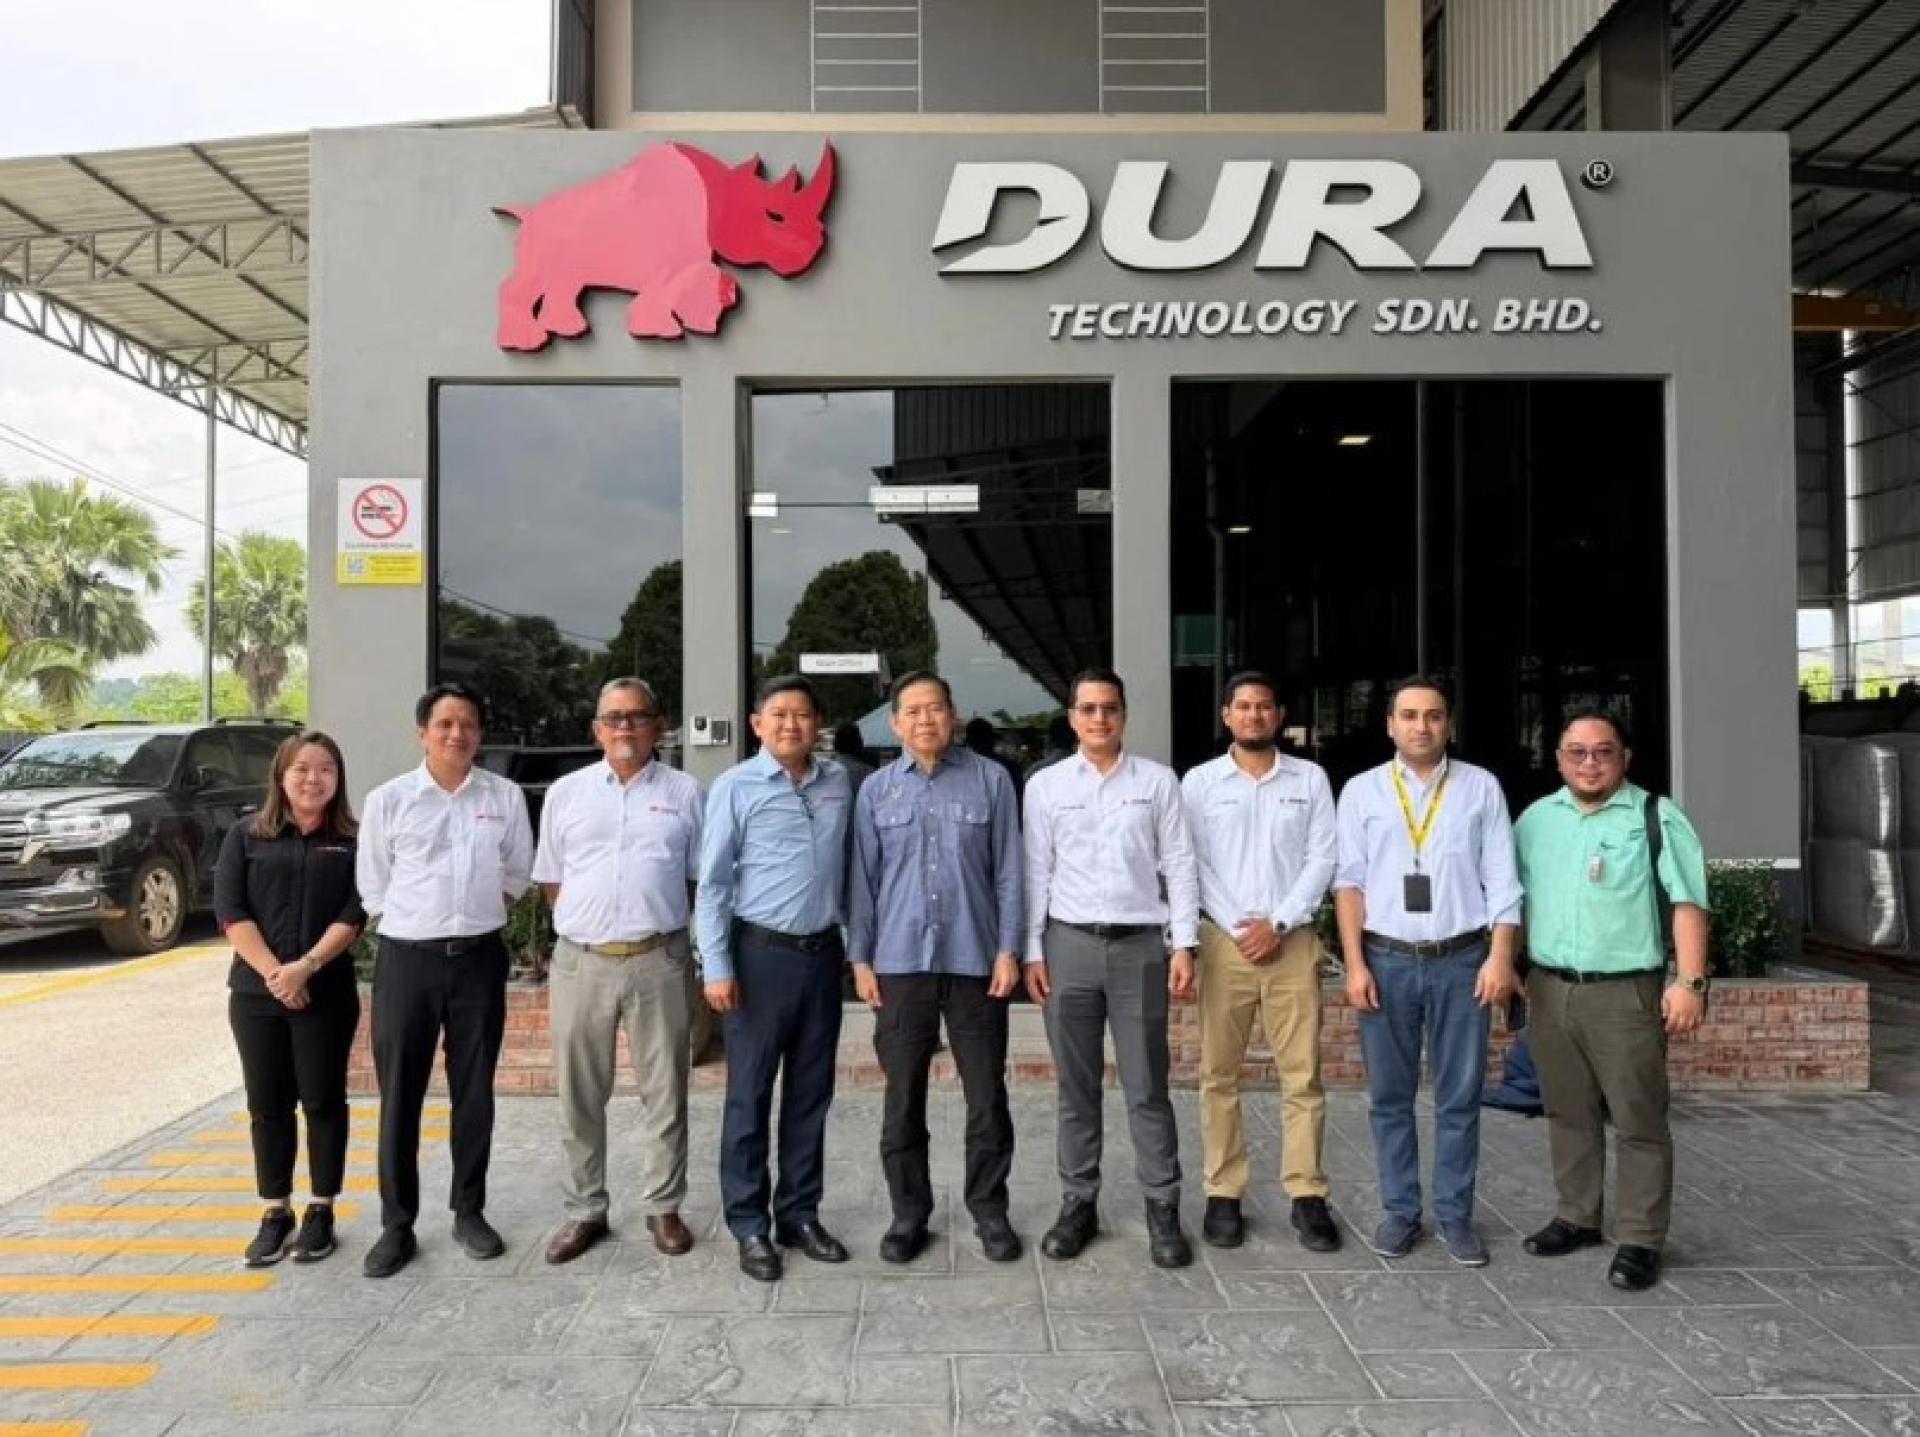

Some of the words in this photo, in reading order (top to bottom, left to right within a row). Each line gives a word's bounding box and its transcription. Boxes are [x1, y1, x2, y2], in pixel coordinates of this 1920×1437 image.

[932, 159, 1593, 270] DURA
[1049, 300, 1357, 338] TECHNOLOGY
[1372, 299, 1478, 333] SDN.
[1494, 298, 1602, 333] BHD.
